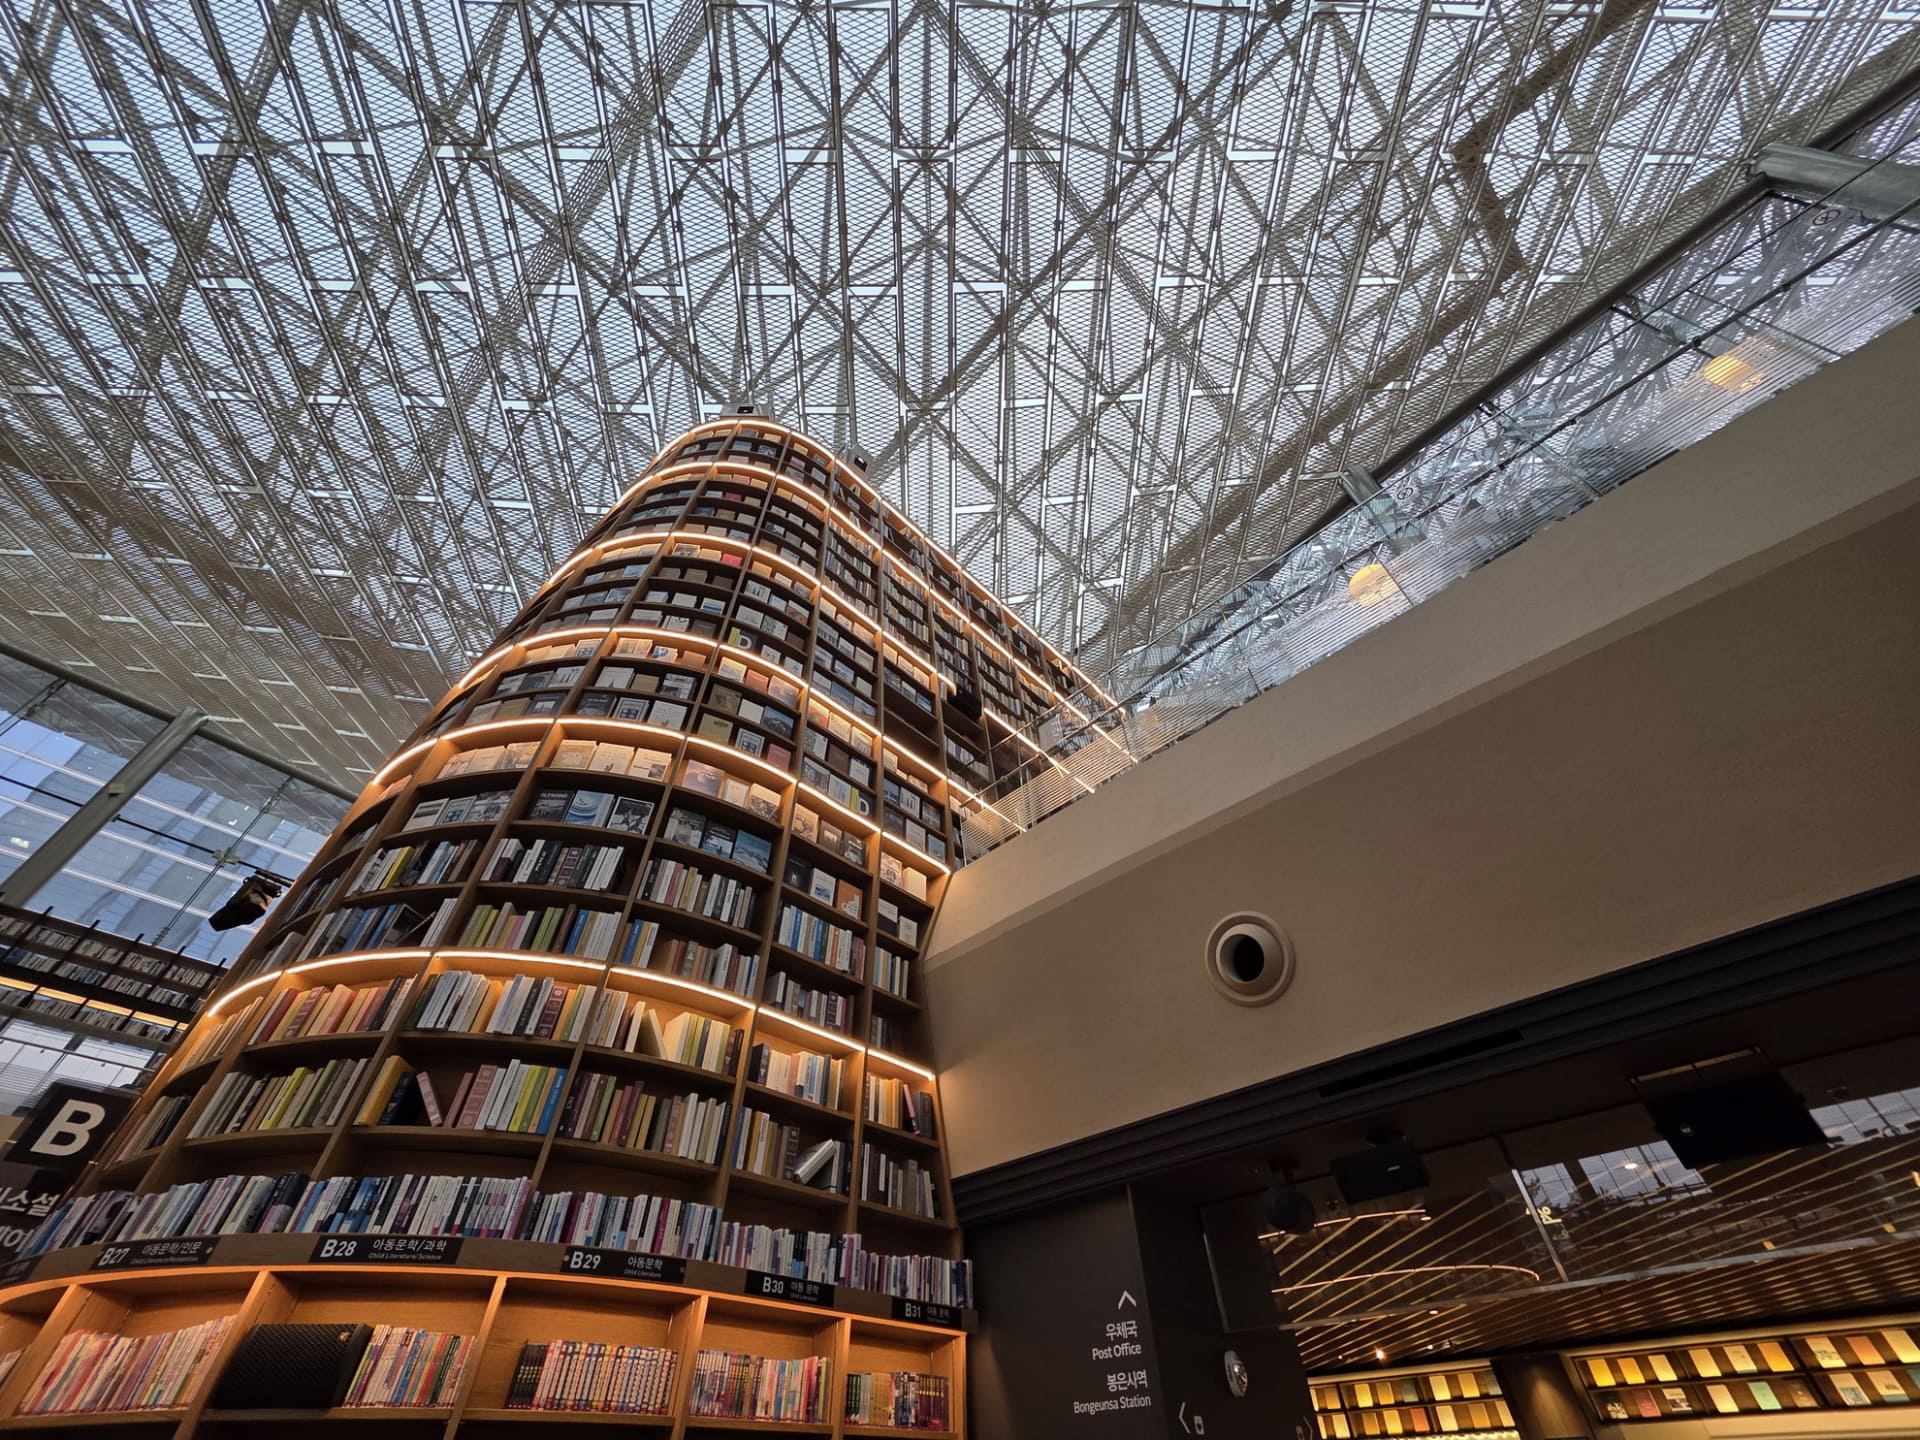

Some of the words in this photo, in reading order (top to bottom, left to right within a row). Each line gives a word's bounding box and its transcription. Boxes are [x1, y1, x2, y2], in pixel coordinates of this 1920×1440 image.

[30, 1099, 106, 1157] B
[319, 1239, 357, 1258] B28
[373, 1238, 447, 1252] 아동문학/과학
[97, 1247, 131, 1266] B27
[570, 1251, 601, 1270] B29
[627, 1256, 663, 1270] 아동문학
[762, 1276, 784, 1294] B30
[905, 1302, 921, 1318] B31
[1106, 1320, 1138, 1341] 우체국
[1092, 1346, 1113, 1360] Post
[1113, 1342, 1142, 1357] Office
[1107, 1369, 1148, 1392] 봉은사역
[1073, 1399, 1119, 1415] Bongeunsa
[1119, 1394, 1152, 1409] Station
